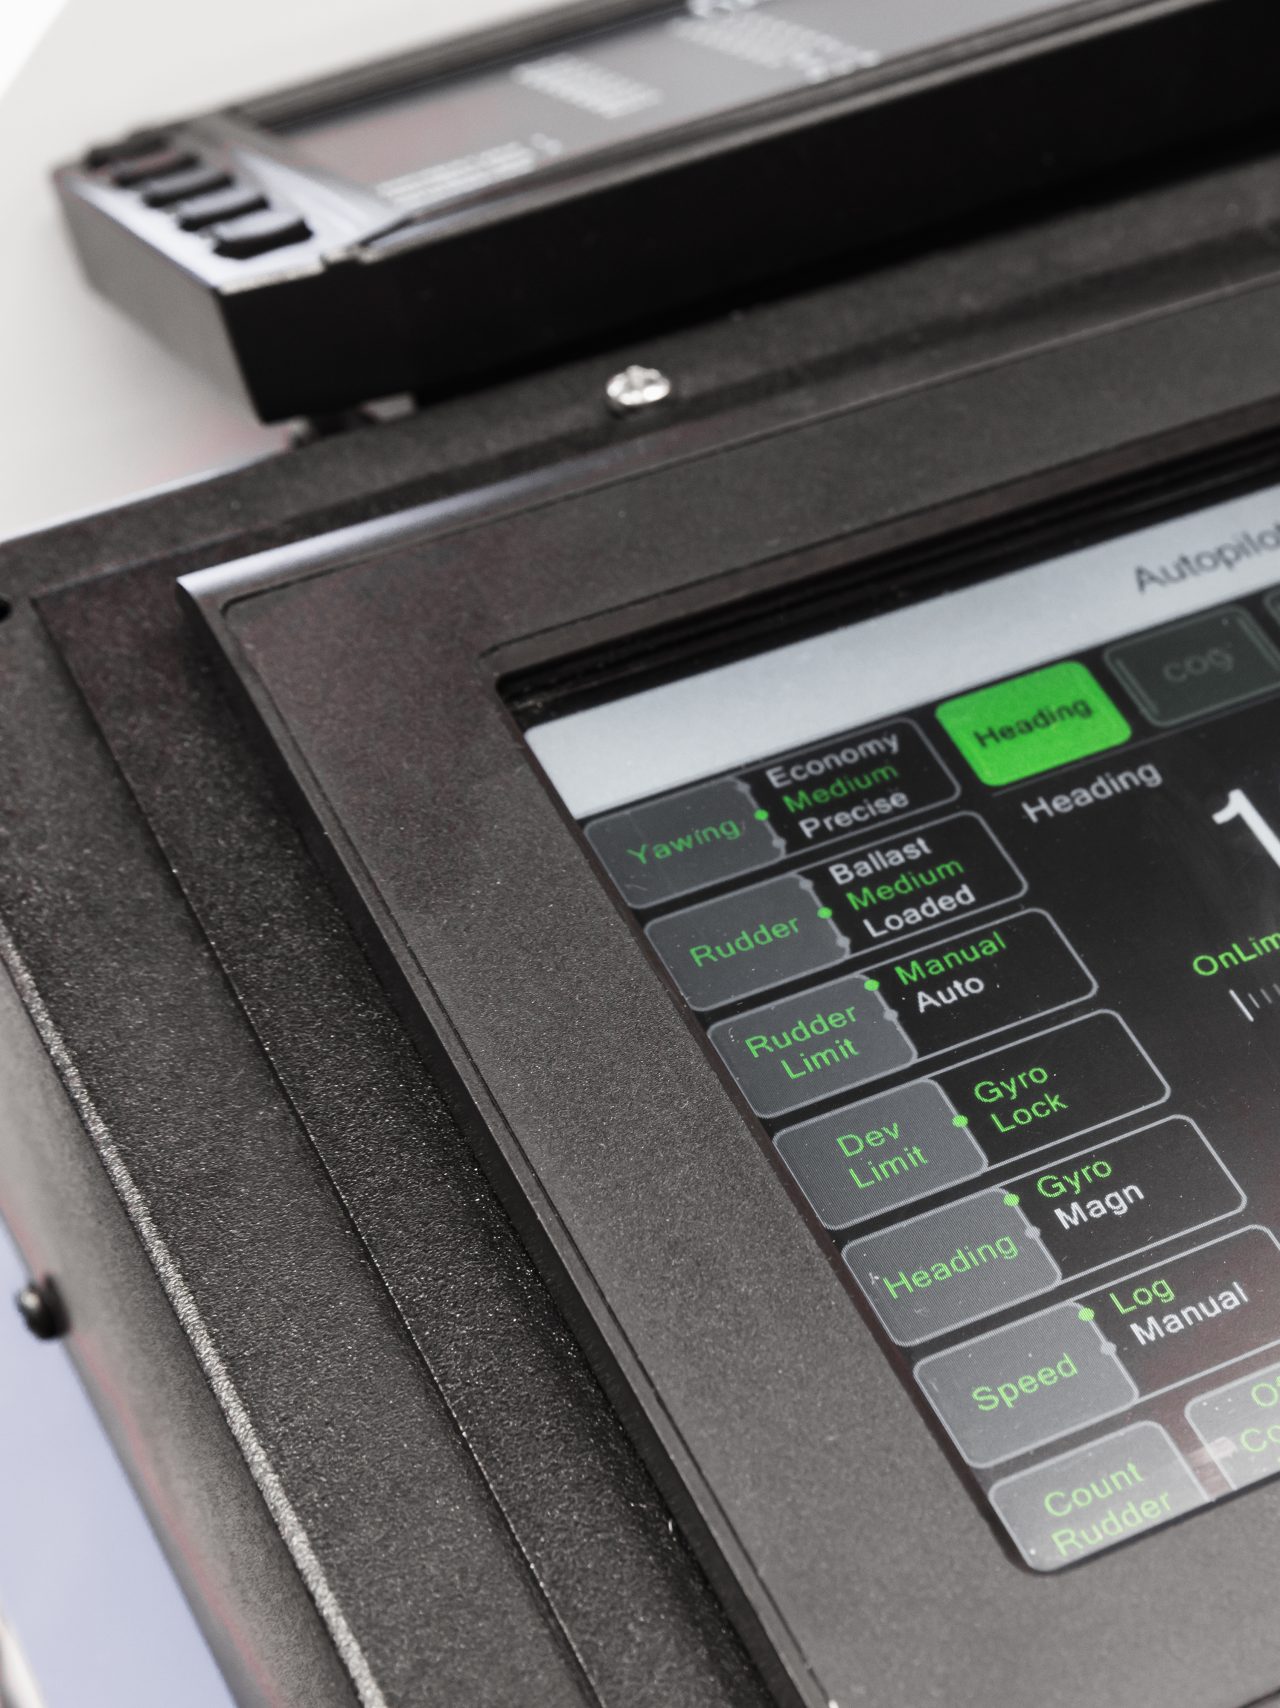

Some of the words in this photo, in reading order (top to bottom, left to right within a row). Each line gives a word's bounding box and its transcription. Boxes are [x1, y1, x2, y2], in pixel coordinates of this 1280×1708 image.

[973, 698, 1092, 749] Heading
[766, 732, 900, 790] Economy
[781, 761, 899, 814] Medium
[1021, 763, 1163, 823] Heading
[798, 790, 910, 840] Precise
[626, 817, 742, 867] Yawing
[828, 838, 932, 886] Ballast
[846, 857, 966, 912] Medium
[863, 885, 977, 938] Loaded
[688, 916, 800, 968] Rudder
[894, 931, 1008, 986] Manual
[916, 975, 985, 1014] Auto
[744, 1004, 857, 1059] Rudder
[780, 1038, 860, 1080] Limit
[973, 1066, 1049, 1105] Gyro
[990, 1091, 1069, 1134] Lock
[836, 1122, 901, 1158] Dev
[849, 1145, 928, 1190] Limit
[1036, 1157, 1113, 1200] Gyro
[1053, 1181, 1145, 1230] Magn
[882, 1232, 1019, 1300] Heading
[1109, 1277, 1176, 1315] Log
[1130, 1281, 1250, 1346] Manual
[971, 1353, 1079, 1412] Speed
[1043, 1461, 1146, 1518] Count
[1050, 1491, 1172, 1557] Rudder
